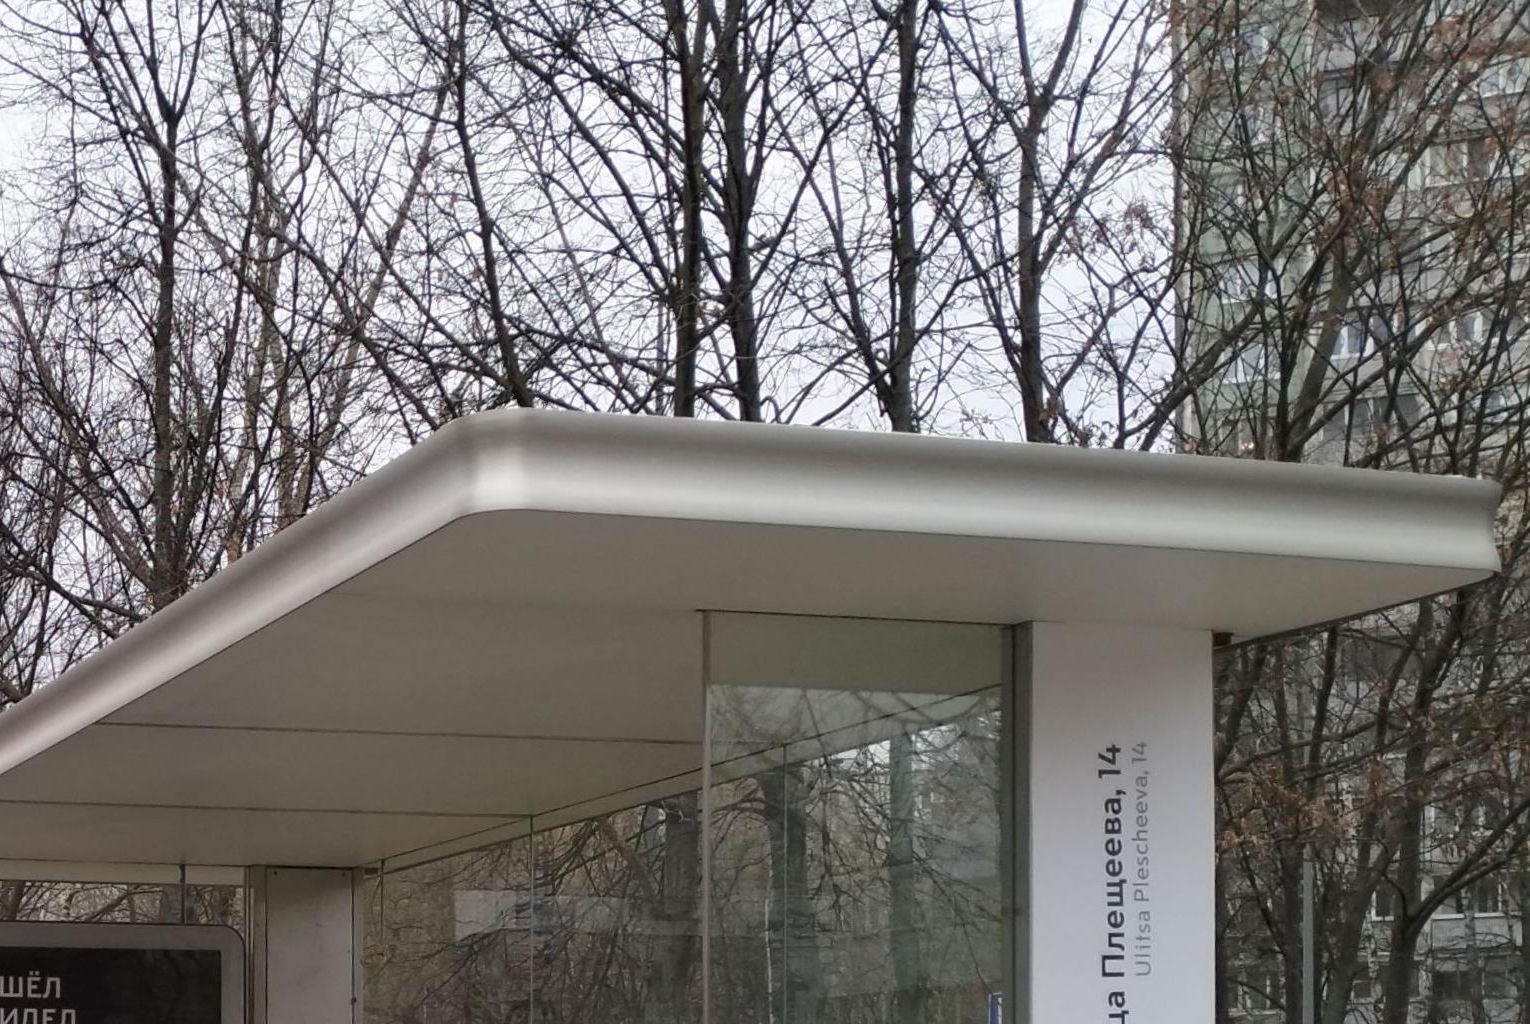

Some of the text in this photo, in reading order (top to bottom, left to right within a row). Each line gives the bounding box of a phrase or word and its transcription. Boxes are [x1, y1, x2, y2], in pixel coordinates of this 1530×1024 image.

[1097, 742, 1122, 780] 14
[1101, 788, 1127, 978] Плещеева,
[1130, 739, 1152, 977] Ulitsa Plescheeva, 14
